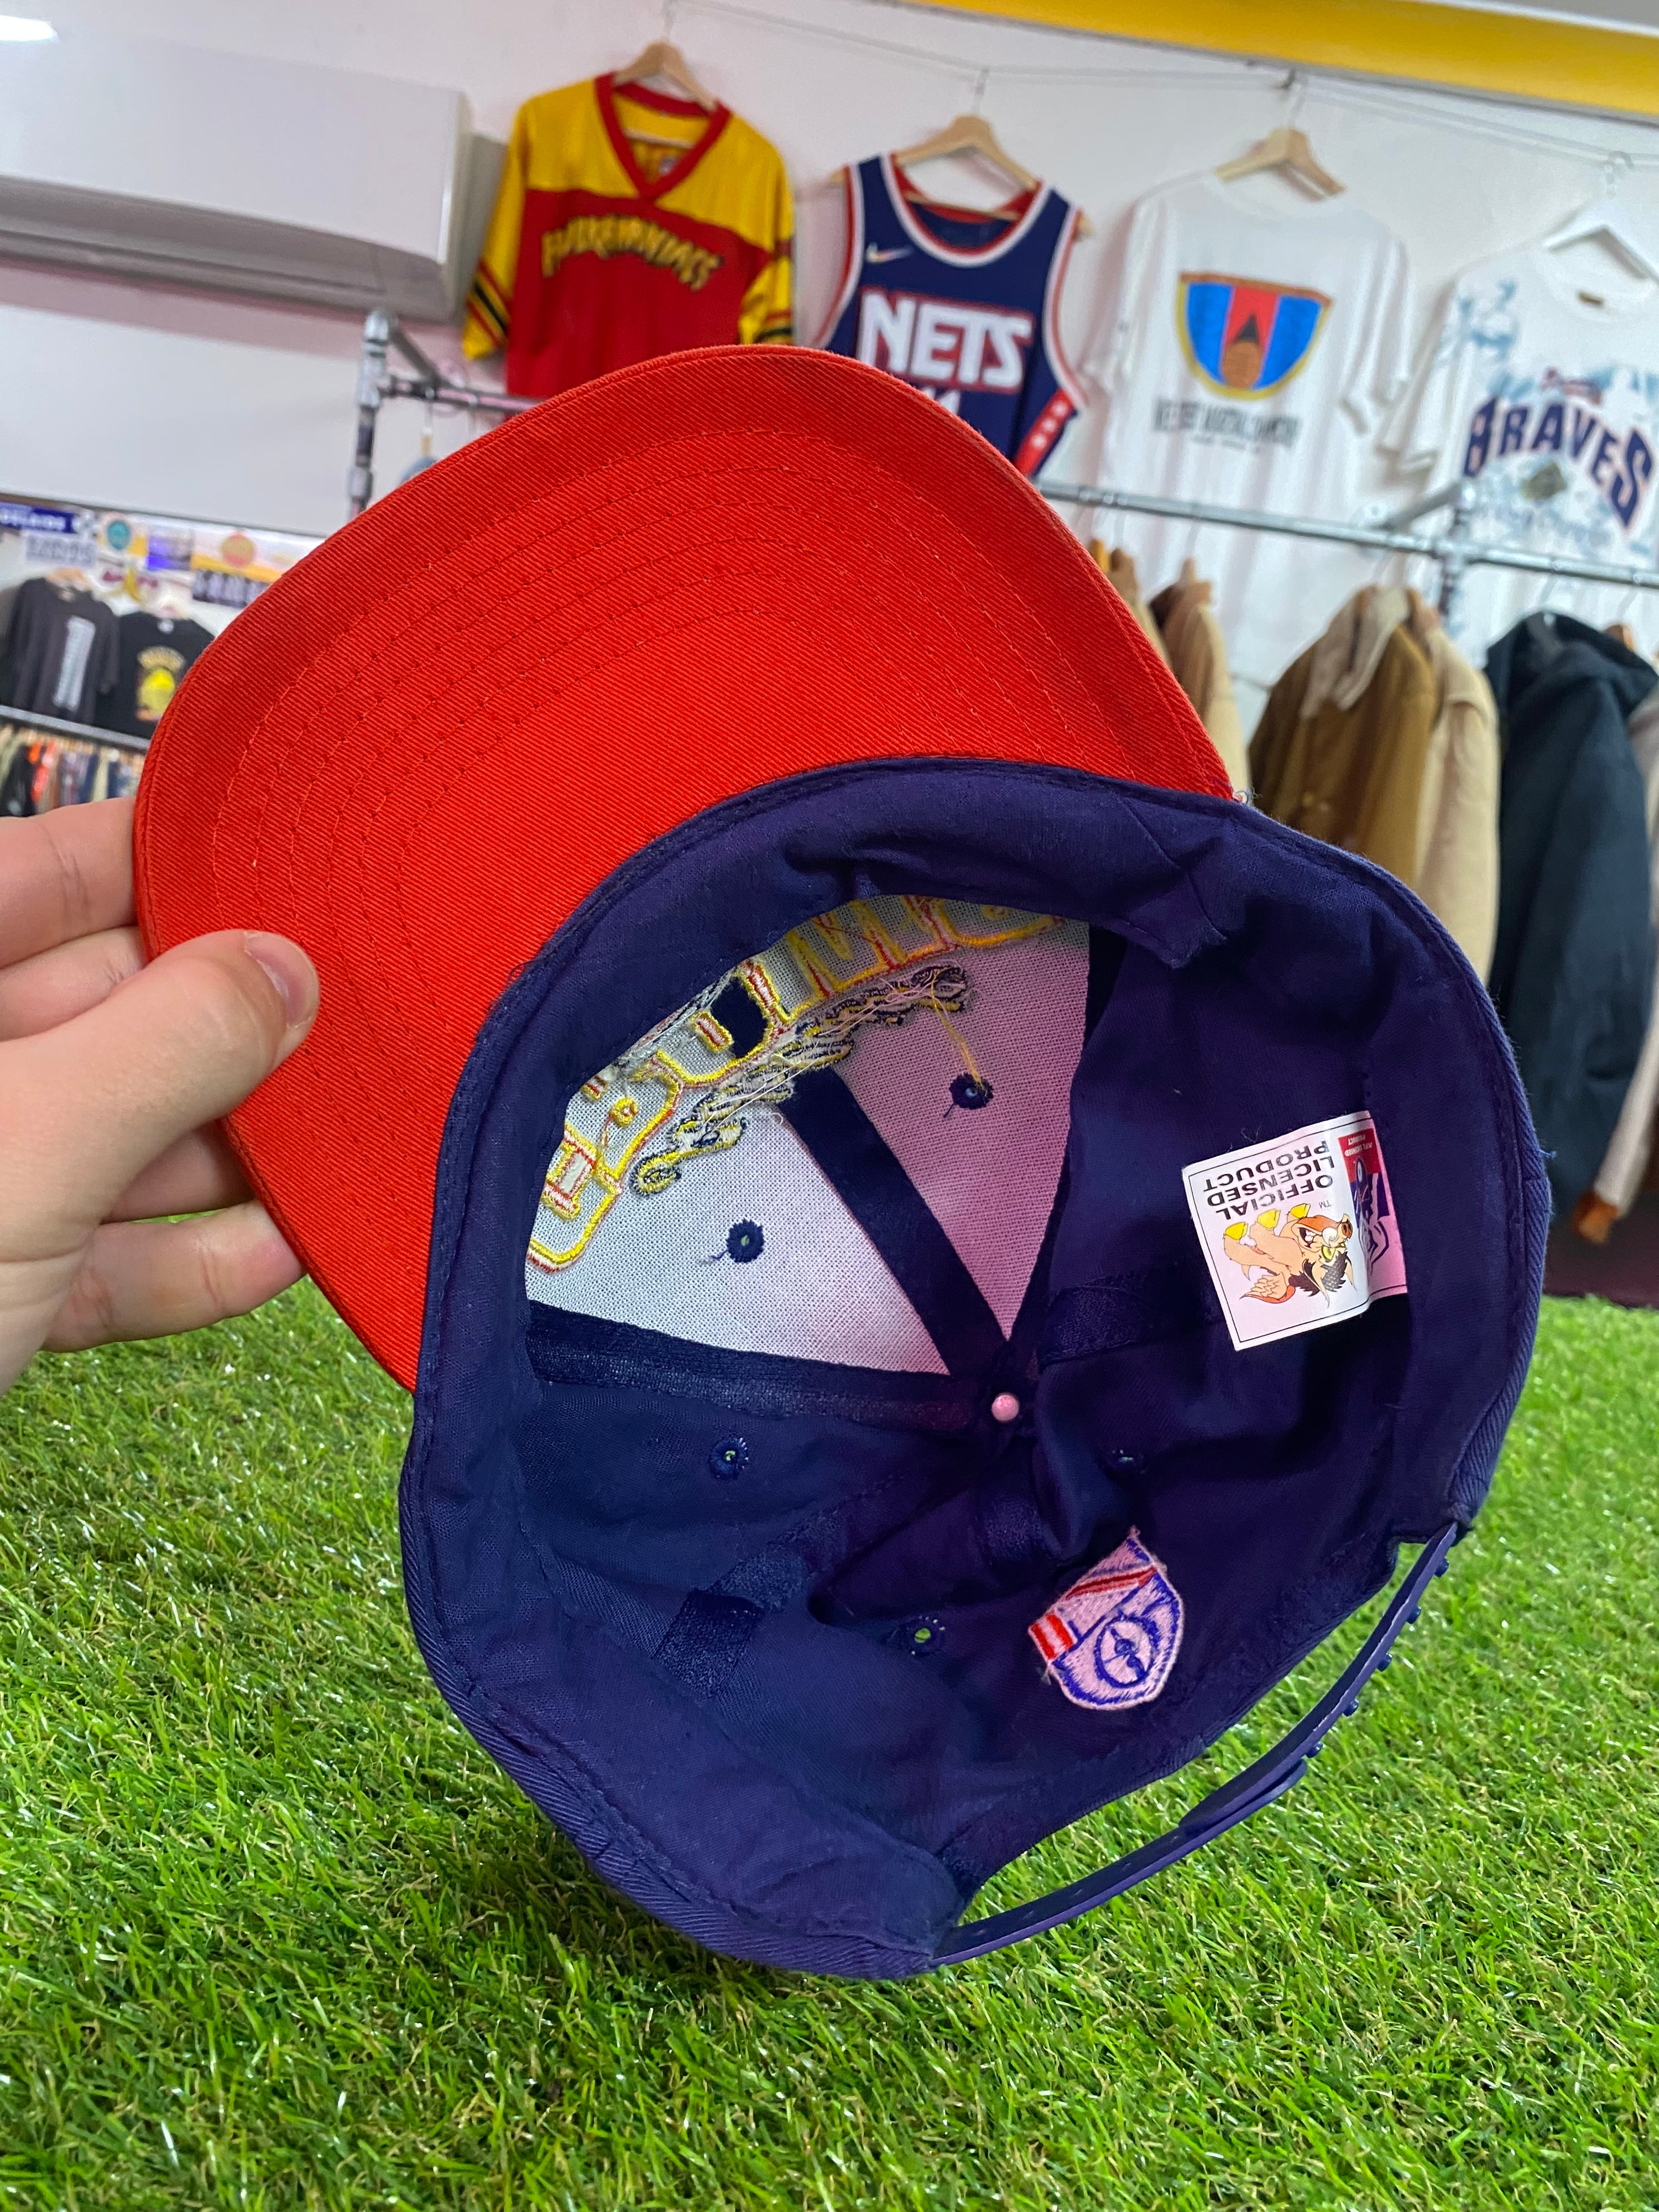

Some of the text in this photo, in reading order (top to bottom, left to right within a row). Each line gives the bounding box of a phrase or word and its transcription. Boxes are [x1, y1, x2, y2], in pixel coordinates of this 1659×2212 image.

[855, 289, 1033, 389] NETS
[1462, 394, 1655, 530] BRAVES
[1203, 1140, 1330, 1192] PRODUCT
[1207, 1155, 1335, 1207] LICENSED
[1215, 1174, 1334, 1220] OFFICIAL
